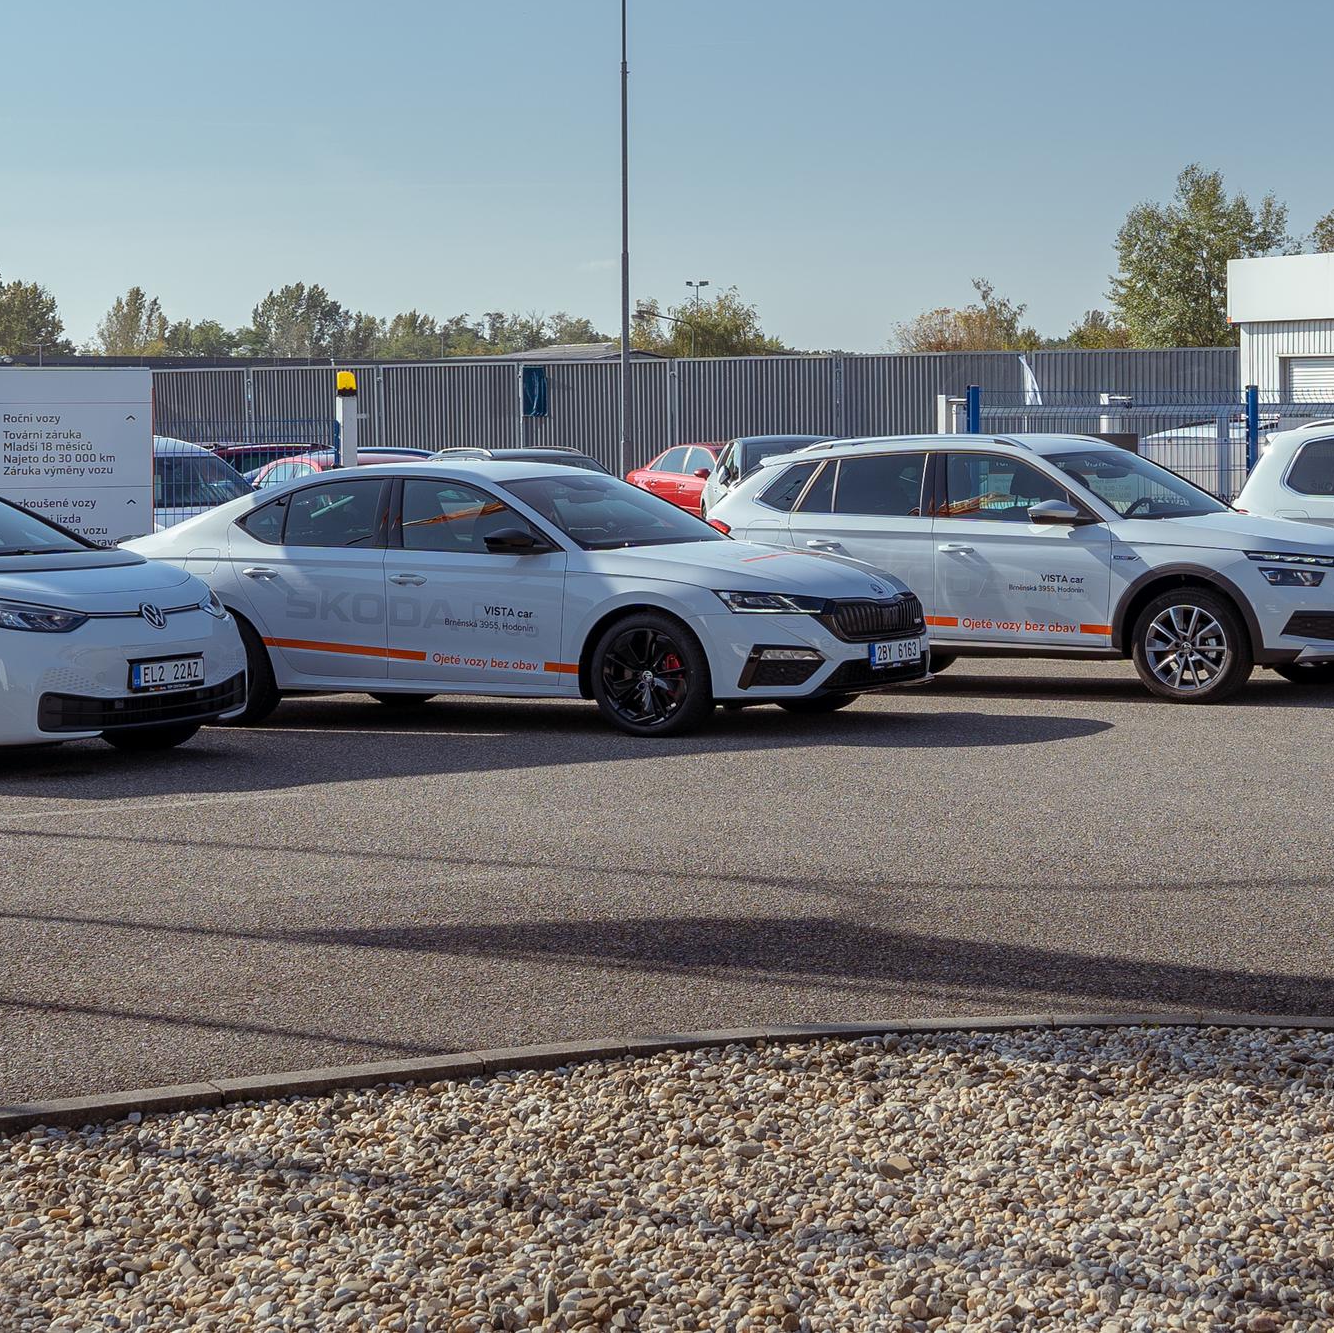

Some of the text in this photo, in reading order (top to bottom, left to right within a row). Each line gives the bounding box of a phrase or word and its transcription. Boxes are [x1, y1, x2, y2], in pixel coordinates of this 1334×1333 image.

[3, 414, 61, 425] Roční vozy
[3, 430, 82, 440] Tovární záruka
[3, 441, 93, 452] Mladší 18 měsíců
[3, 453, 116, 466] Najeto do 30 000 km
[3, 466, 114, 477] Záruka výměny vozu
[71, 499, 97, 509] vozy
[83, 527, 108, 535] vozu
[1041, 573, 1084, 584] VISTA car
[483, 605, 534, 618] VISTA car
[962, 617, 1077, 634] Ojeté vozy bez obav
[877, 641, 917, 662] 2BY 6163
[432, 652, 539, 672] Ojeté vozy bez obav
[143, 661, 200, 684] EL2 22AZ
